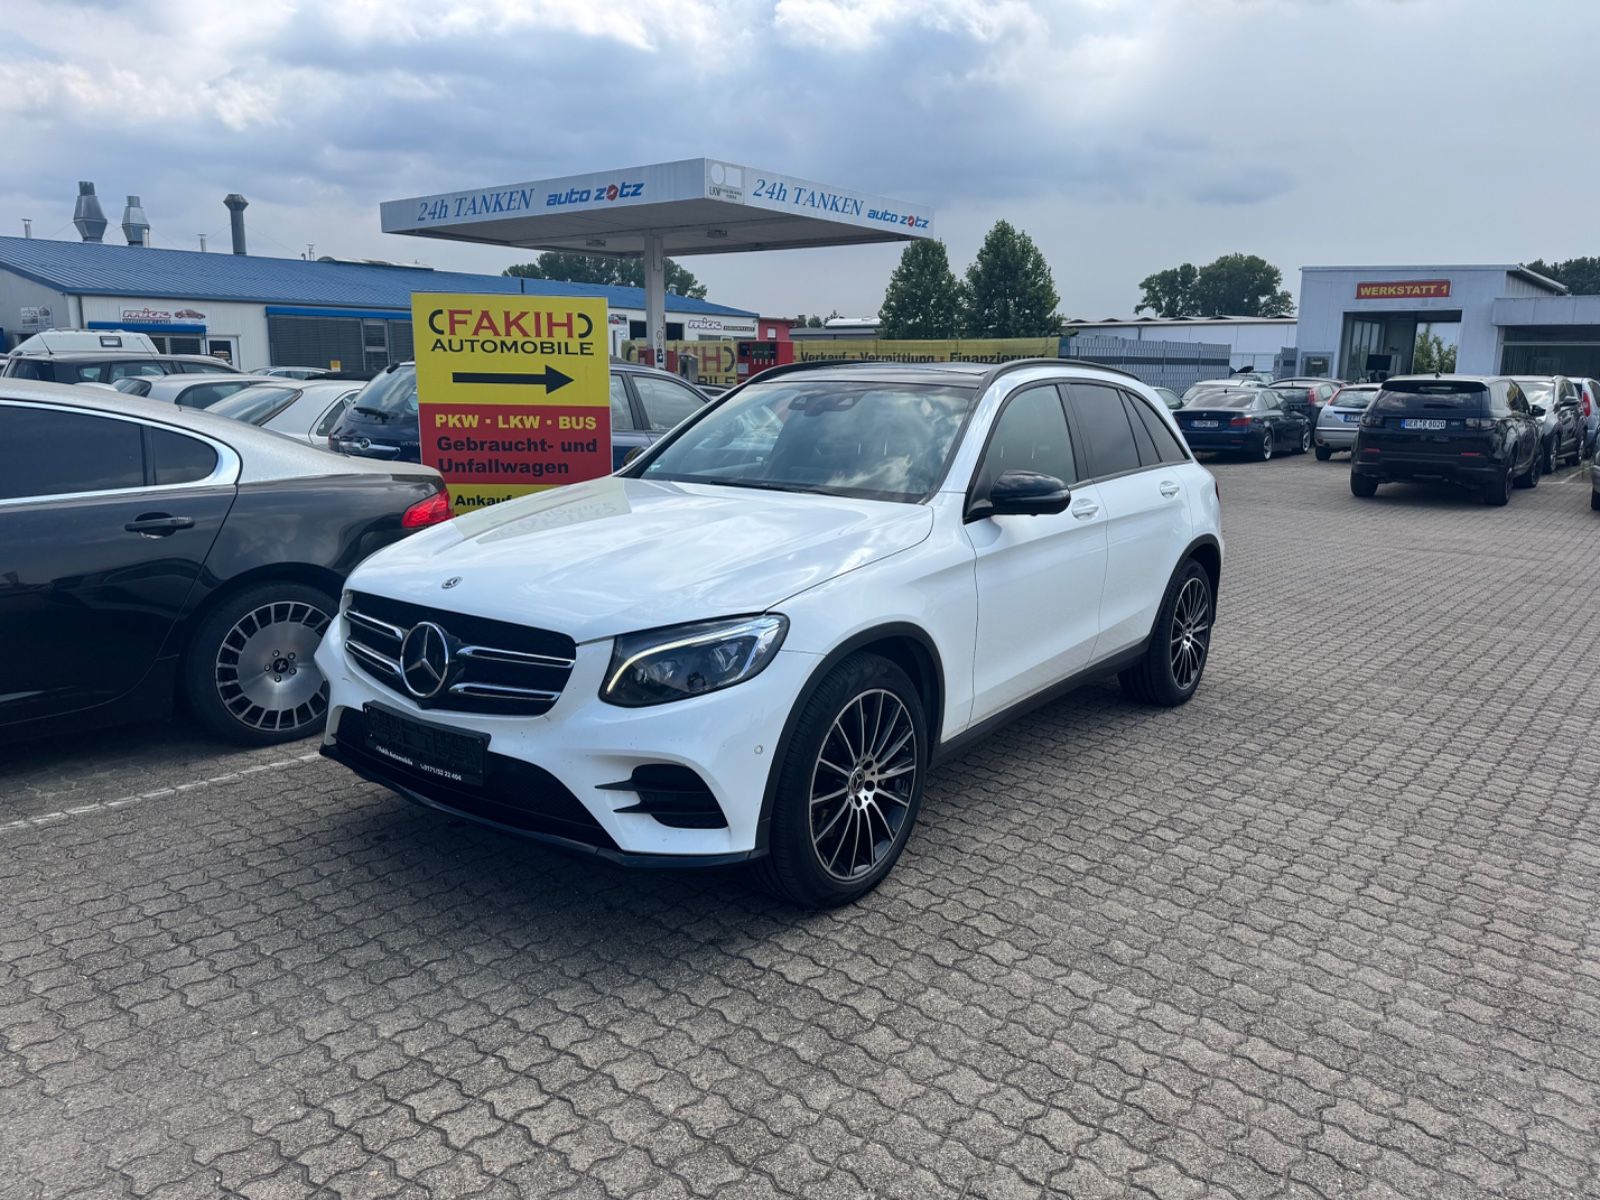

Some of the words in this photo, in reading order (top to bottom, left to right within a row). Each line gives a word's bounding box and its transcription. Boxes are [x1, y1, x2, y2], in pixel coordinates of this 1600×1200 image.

[417, 201, 448, 222] 24h
[454, 188, 536, 217] TANKEN
[546, 188, 591, 207] auto
[752, 178, 788, 202] 24h
[793, 186, 865, 217] TANKEN
[867, 208, 898, 223] auto
[1360, 285, 1437, 296] WERKSTATT
[1440, 284, 1448, 294] 1
[447, 309, 574, 338] FAKIH
[431, 338, 595, 356] AUTOMOBILE
[435, 414, 479, 428] PKW
[498, 415, 540, 429] LKW
[558, 416, 597, 430] BUS
[437, 436, 554, 453] Gebraucht-
[561, 438, 598, 453] und
[438, 458, 569, 477] Unfallwagen
